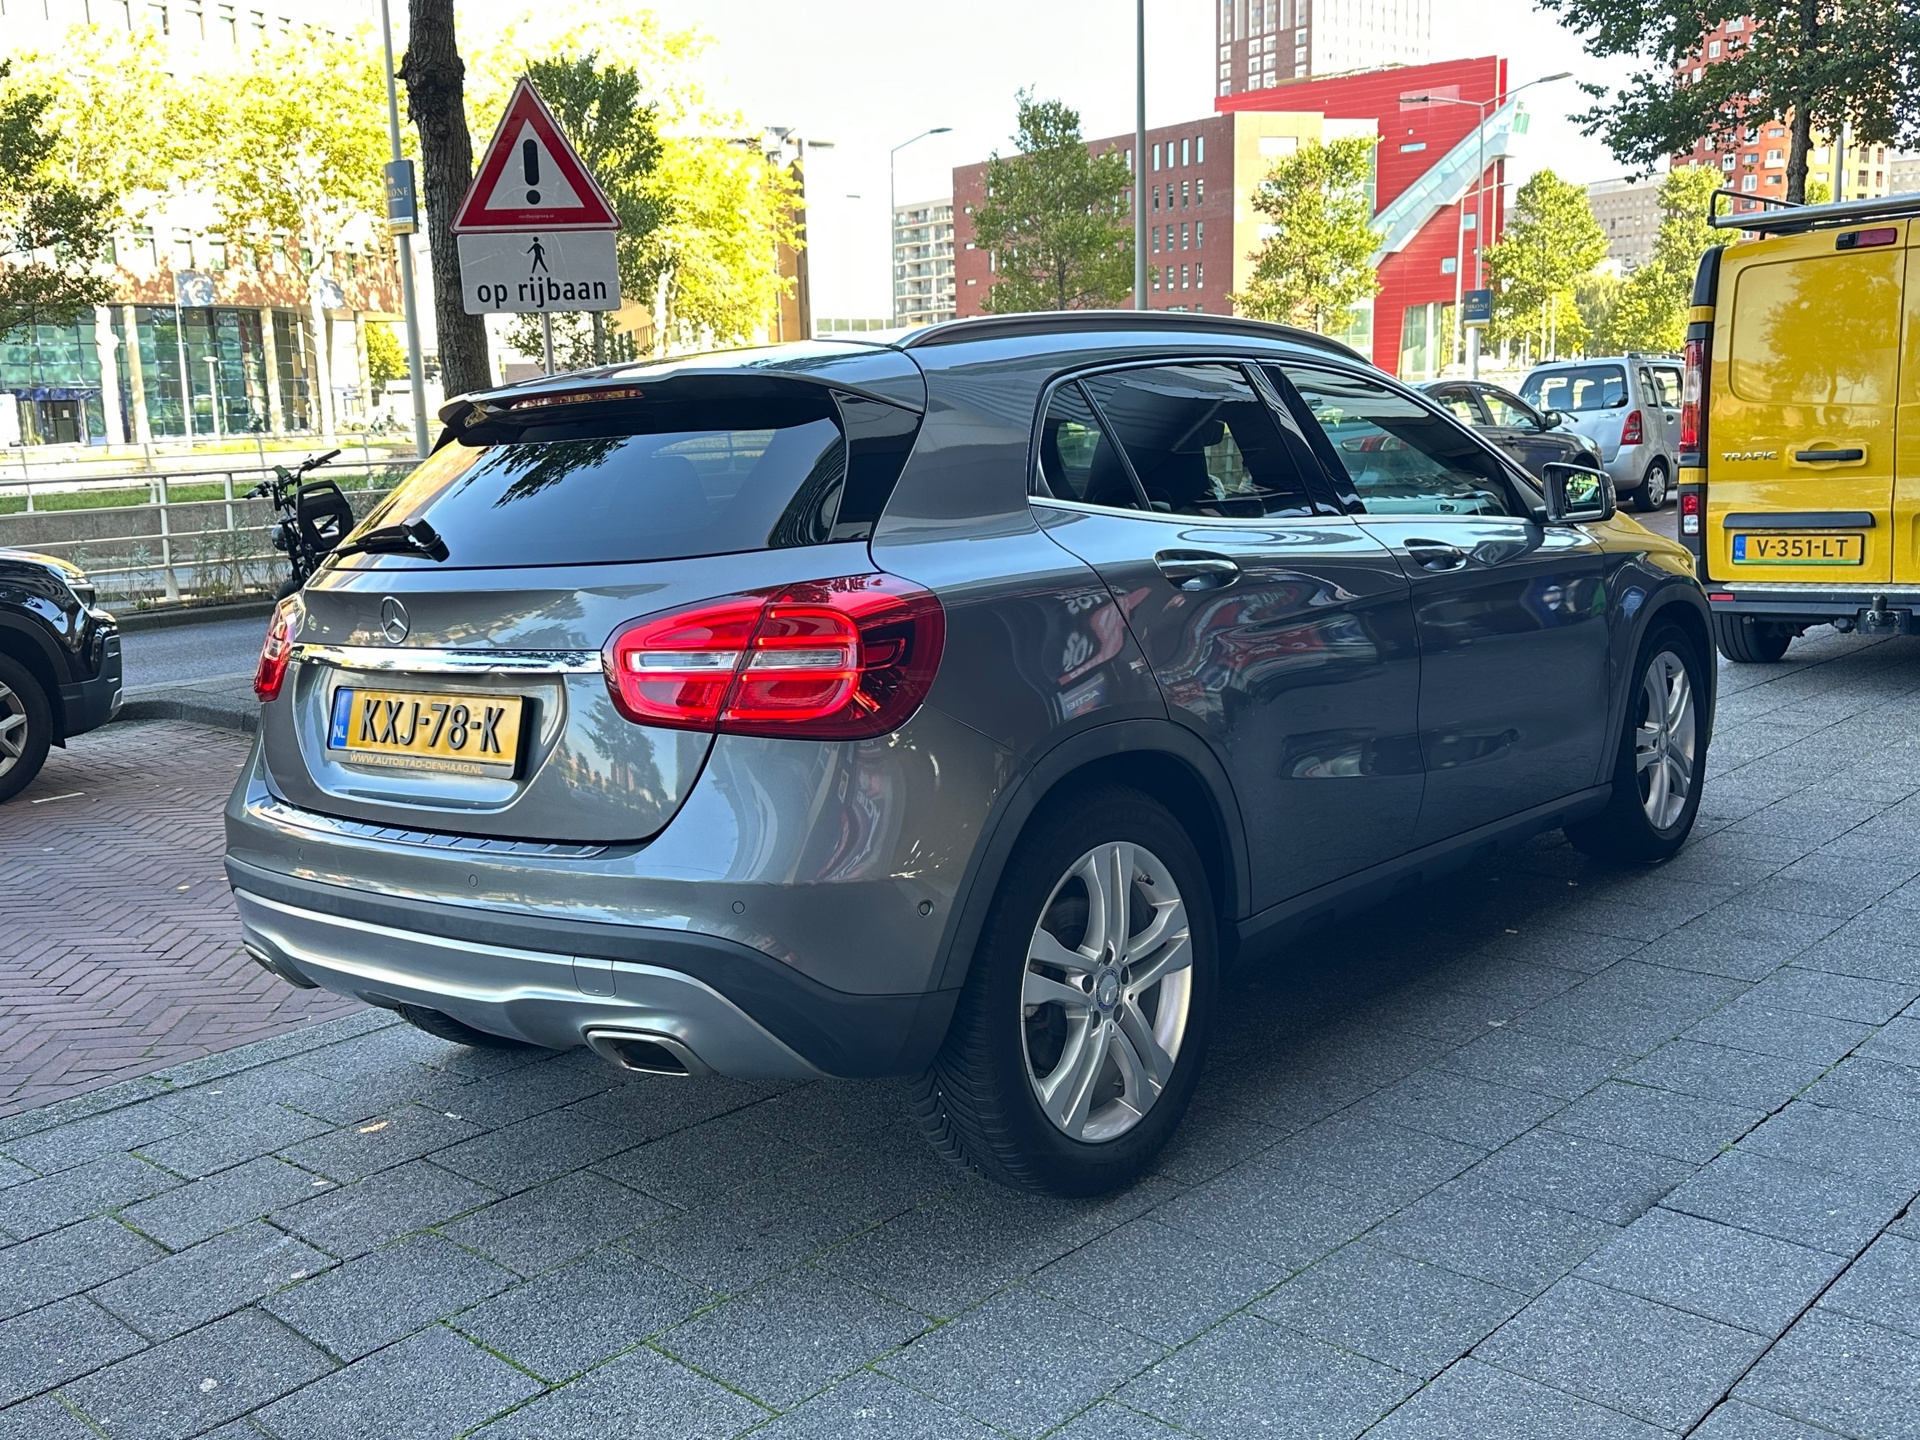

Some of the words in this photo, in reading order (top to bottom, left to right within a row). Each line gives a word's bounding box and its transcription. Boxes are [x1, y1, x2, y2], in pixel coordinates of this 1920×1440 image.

[477, 284, 508, 309] op
[518, 276, 607, 308] rijbaan
[1721, 451, 1778, 461] TRAFIC
[1757, 539, 1848, 557] V-351-LT
[334, 725, 346, 738] NL
[360, 699, 505, 753] KXJ-78-K
[350, 753, 483, 775] WWW.AUTOSTAD-DENHAAG.NL
